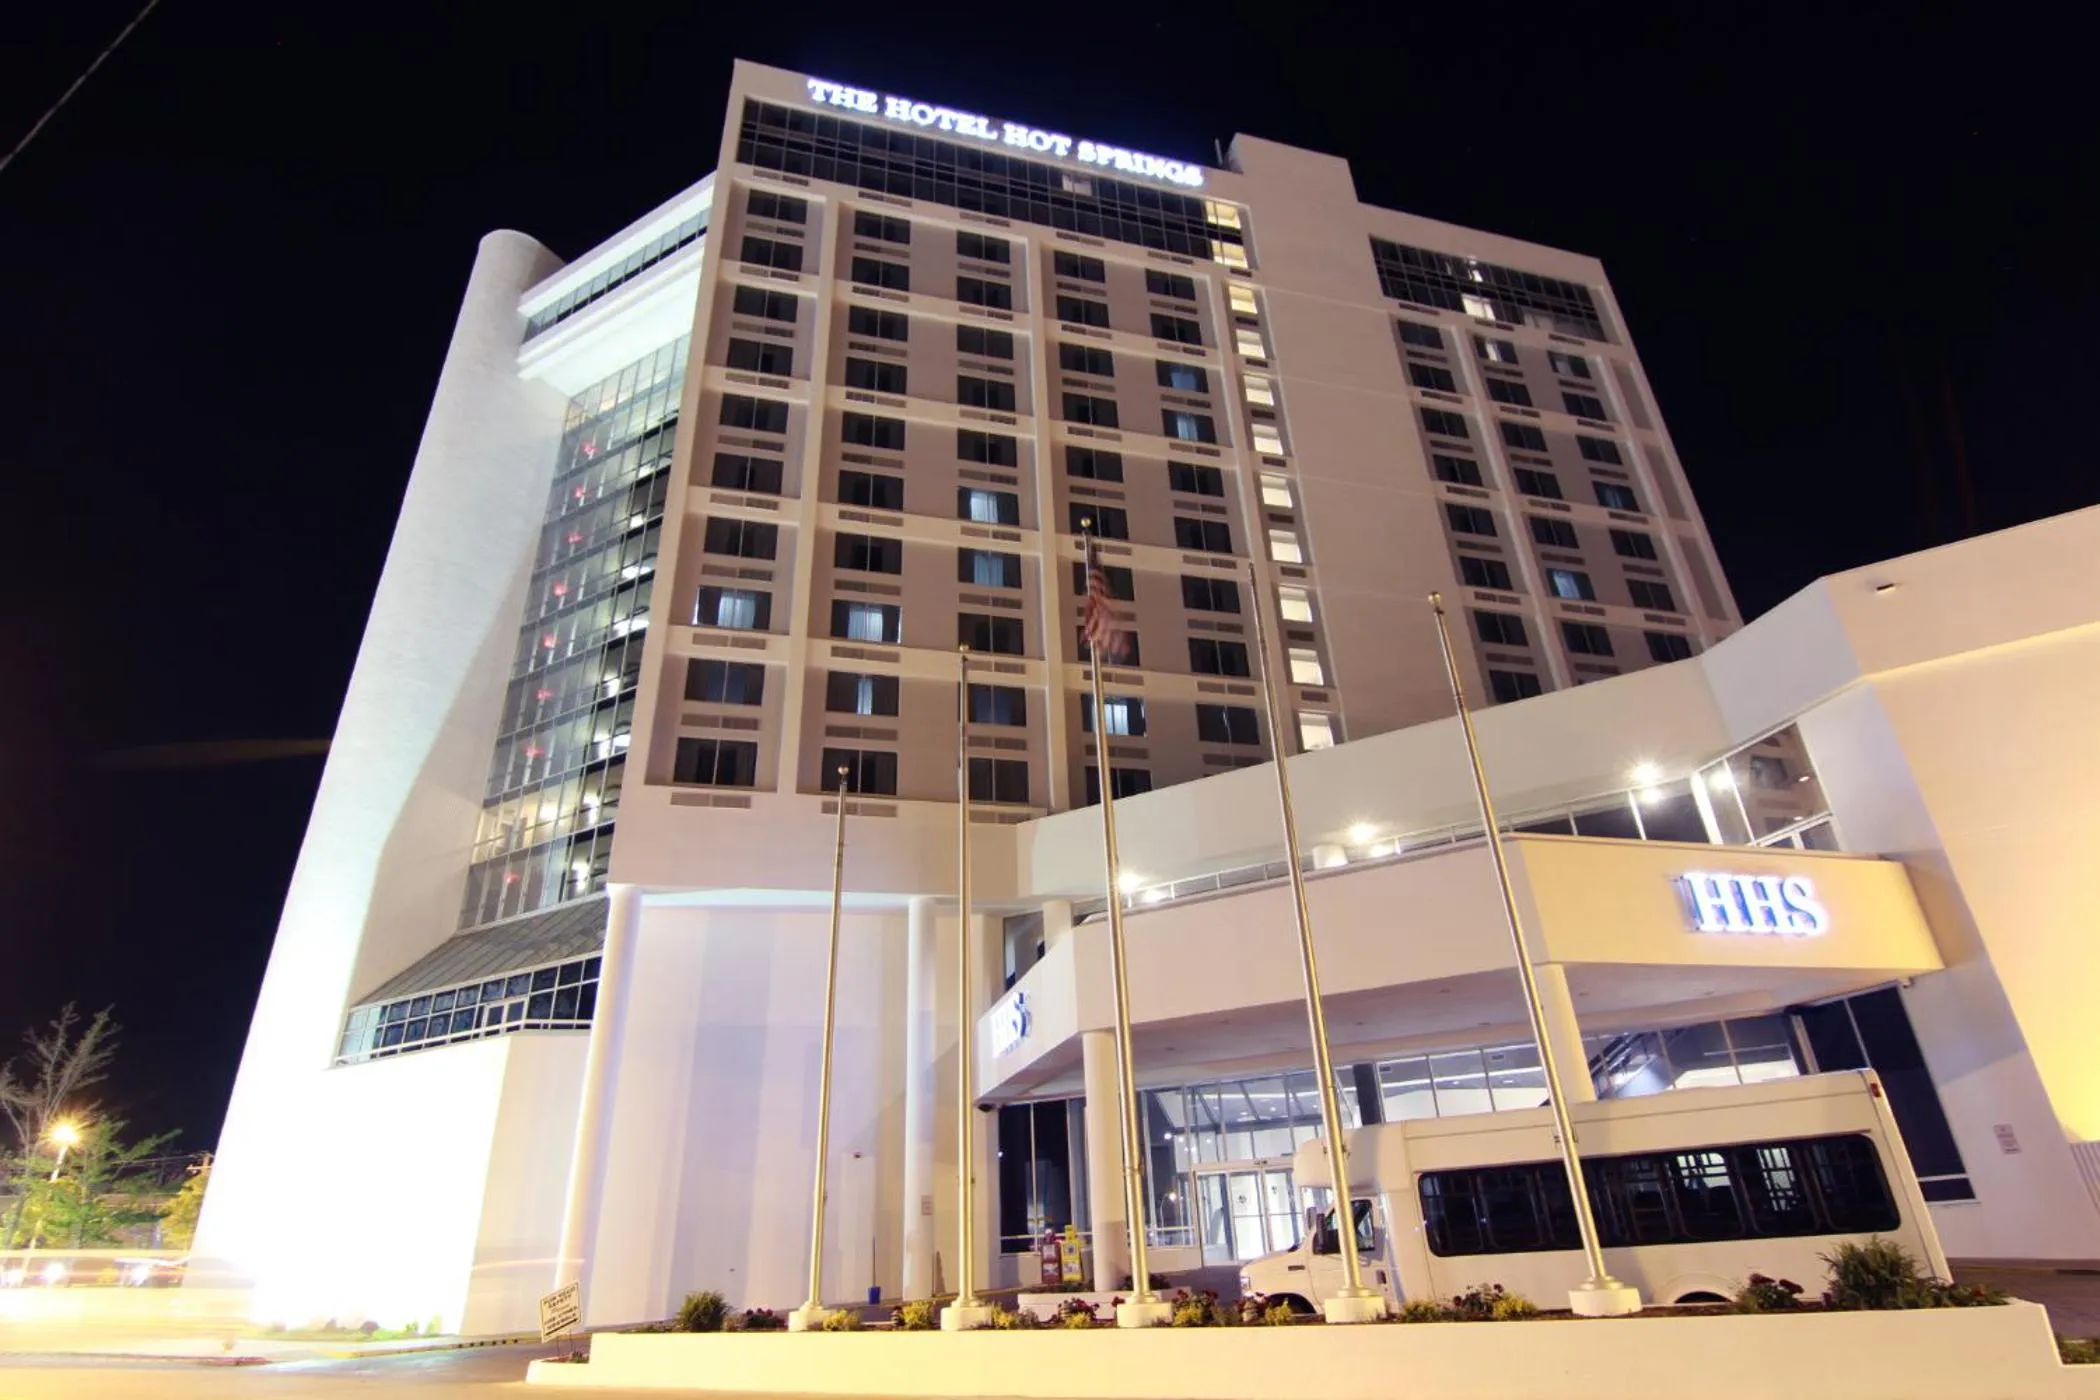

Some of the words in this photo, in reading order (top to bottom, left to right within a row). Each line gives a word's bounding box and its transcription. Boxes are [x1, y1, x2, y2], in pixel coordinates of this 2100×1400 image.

[807, 78, 878, 113] THE
[885, 96, 998, 140] HOTEL
[1003, 122, 1072, 157] HOT
[1078, 140, 1204, 187] SPRINGS
[1675, 872, 1829, 935] HHS
